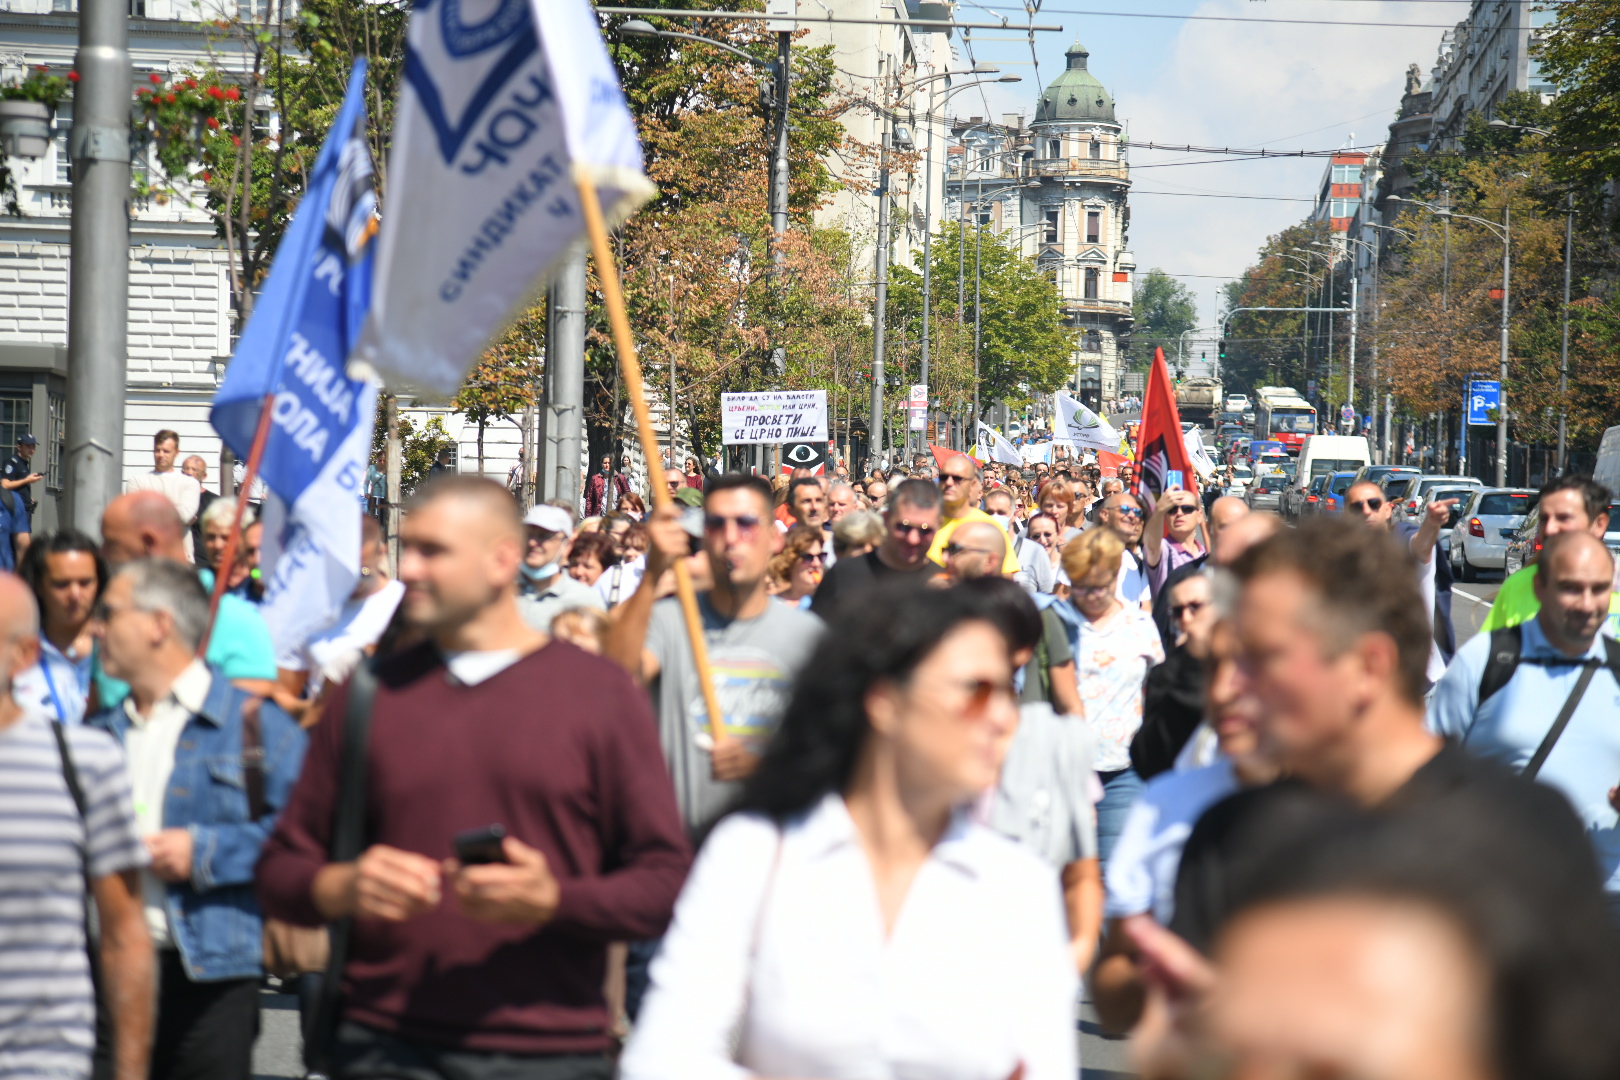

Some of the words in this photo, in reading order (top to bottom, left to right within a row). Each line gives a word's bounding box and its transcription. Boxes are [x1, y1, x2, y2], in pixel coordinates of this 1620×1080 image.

[438, 152, 565, 304] СИНДИКАТ
[284, 331, 354, 425] НИЈА
[734, 429, 745, 440] СЕ
[749, 427, 782, 441] ЦРНО
[785, 425, 817, 438] ПИШЕ
[744, 413, 803, 427] ПРОСВЕТИ
